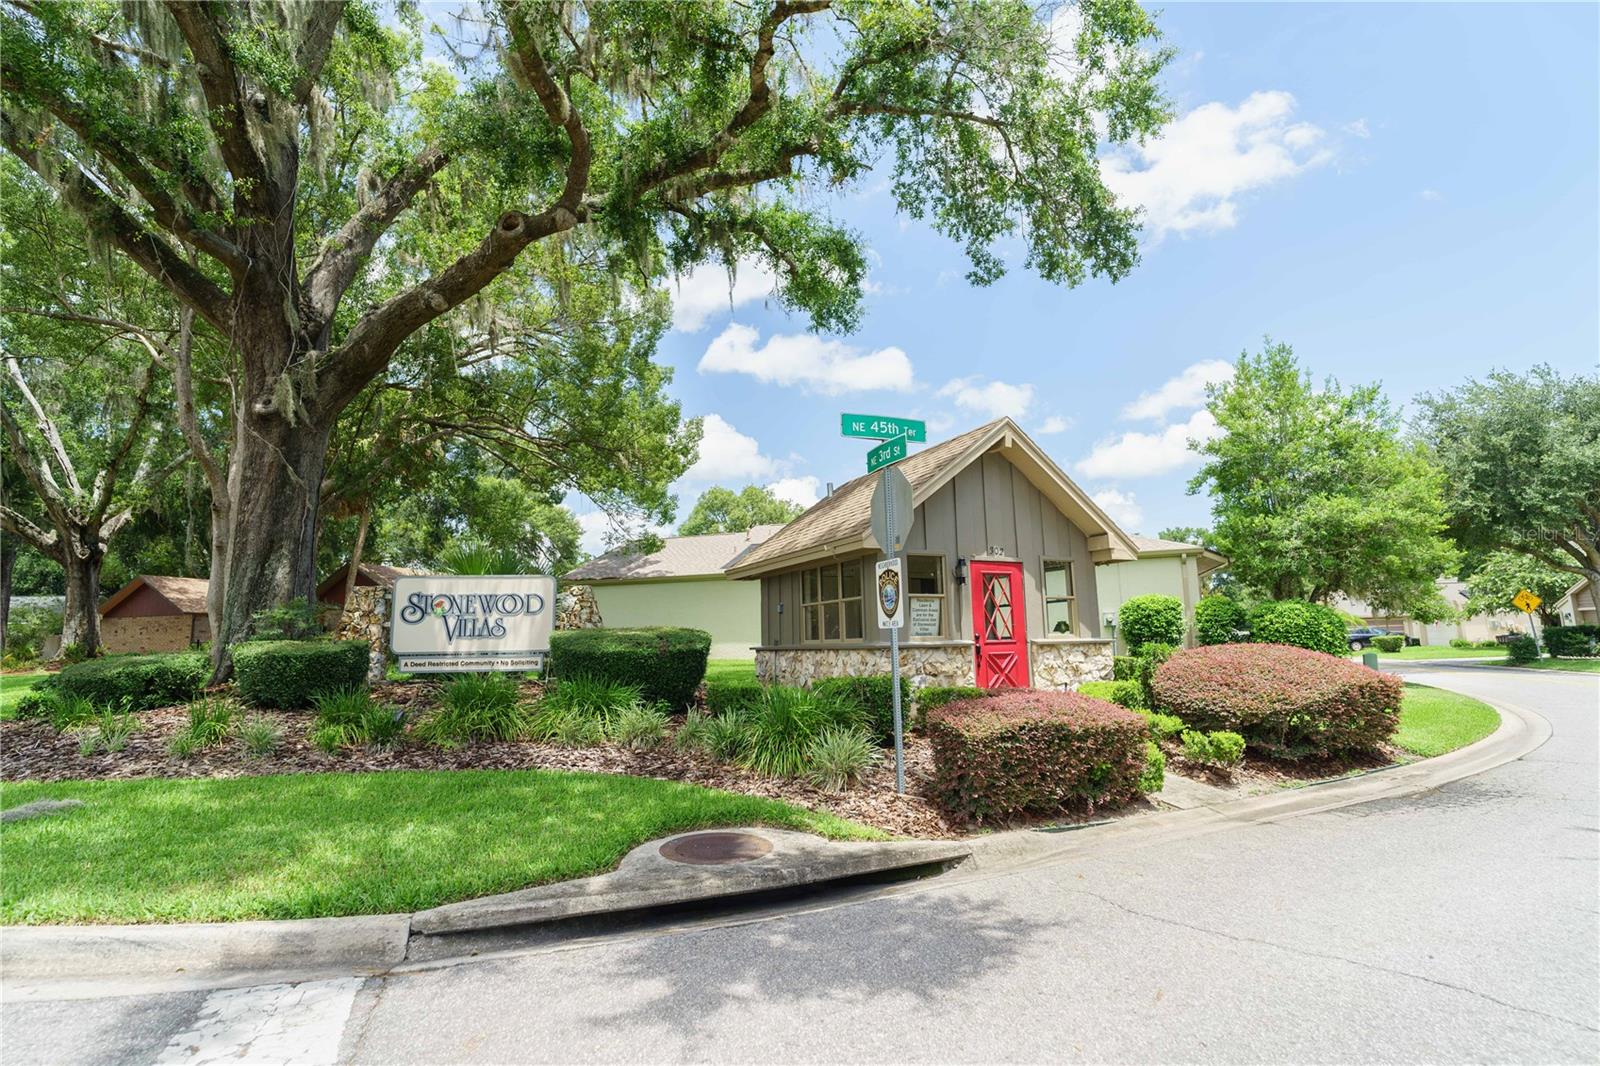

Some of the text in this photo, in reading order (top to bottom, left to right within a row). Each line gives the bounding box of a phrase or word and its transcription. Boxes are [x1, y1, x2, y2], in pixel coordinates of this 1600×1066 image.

[852, 421, 916, 437] NE 45th Ter
[879, 447, 891, 462] 3rd
[893, 446, 900, 456] St
[880, 572, 898, 587] POLICE
[402, 592, 544, 624] STONEWOOD
[442, 615, 506, 644] VILLAS
